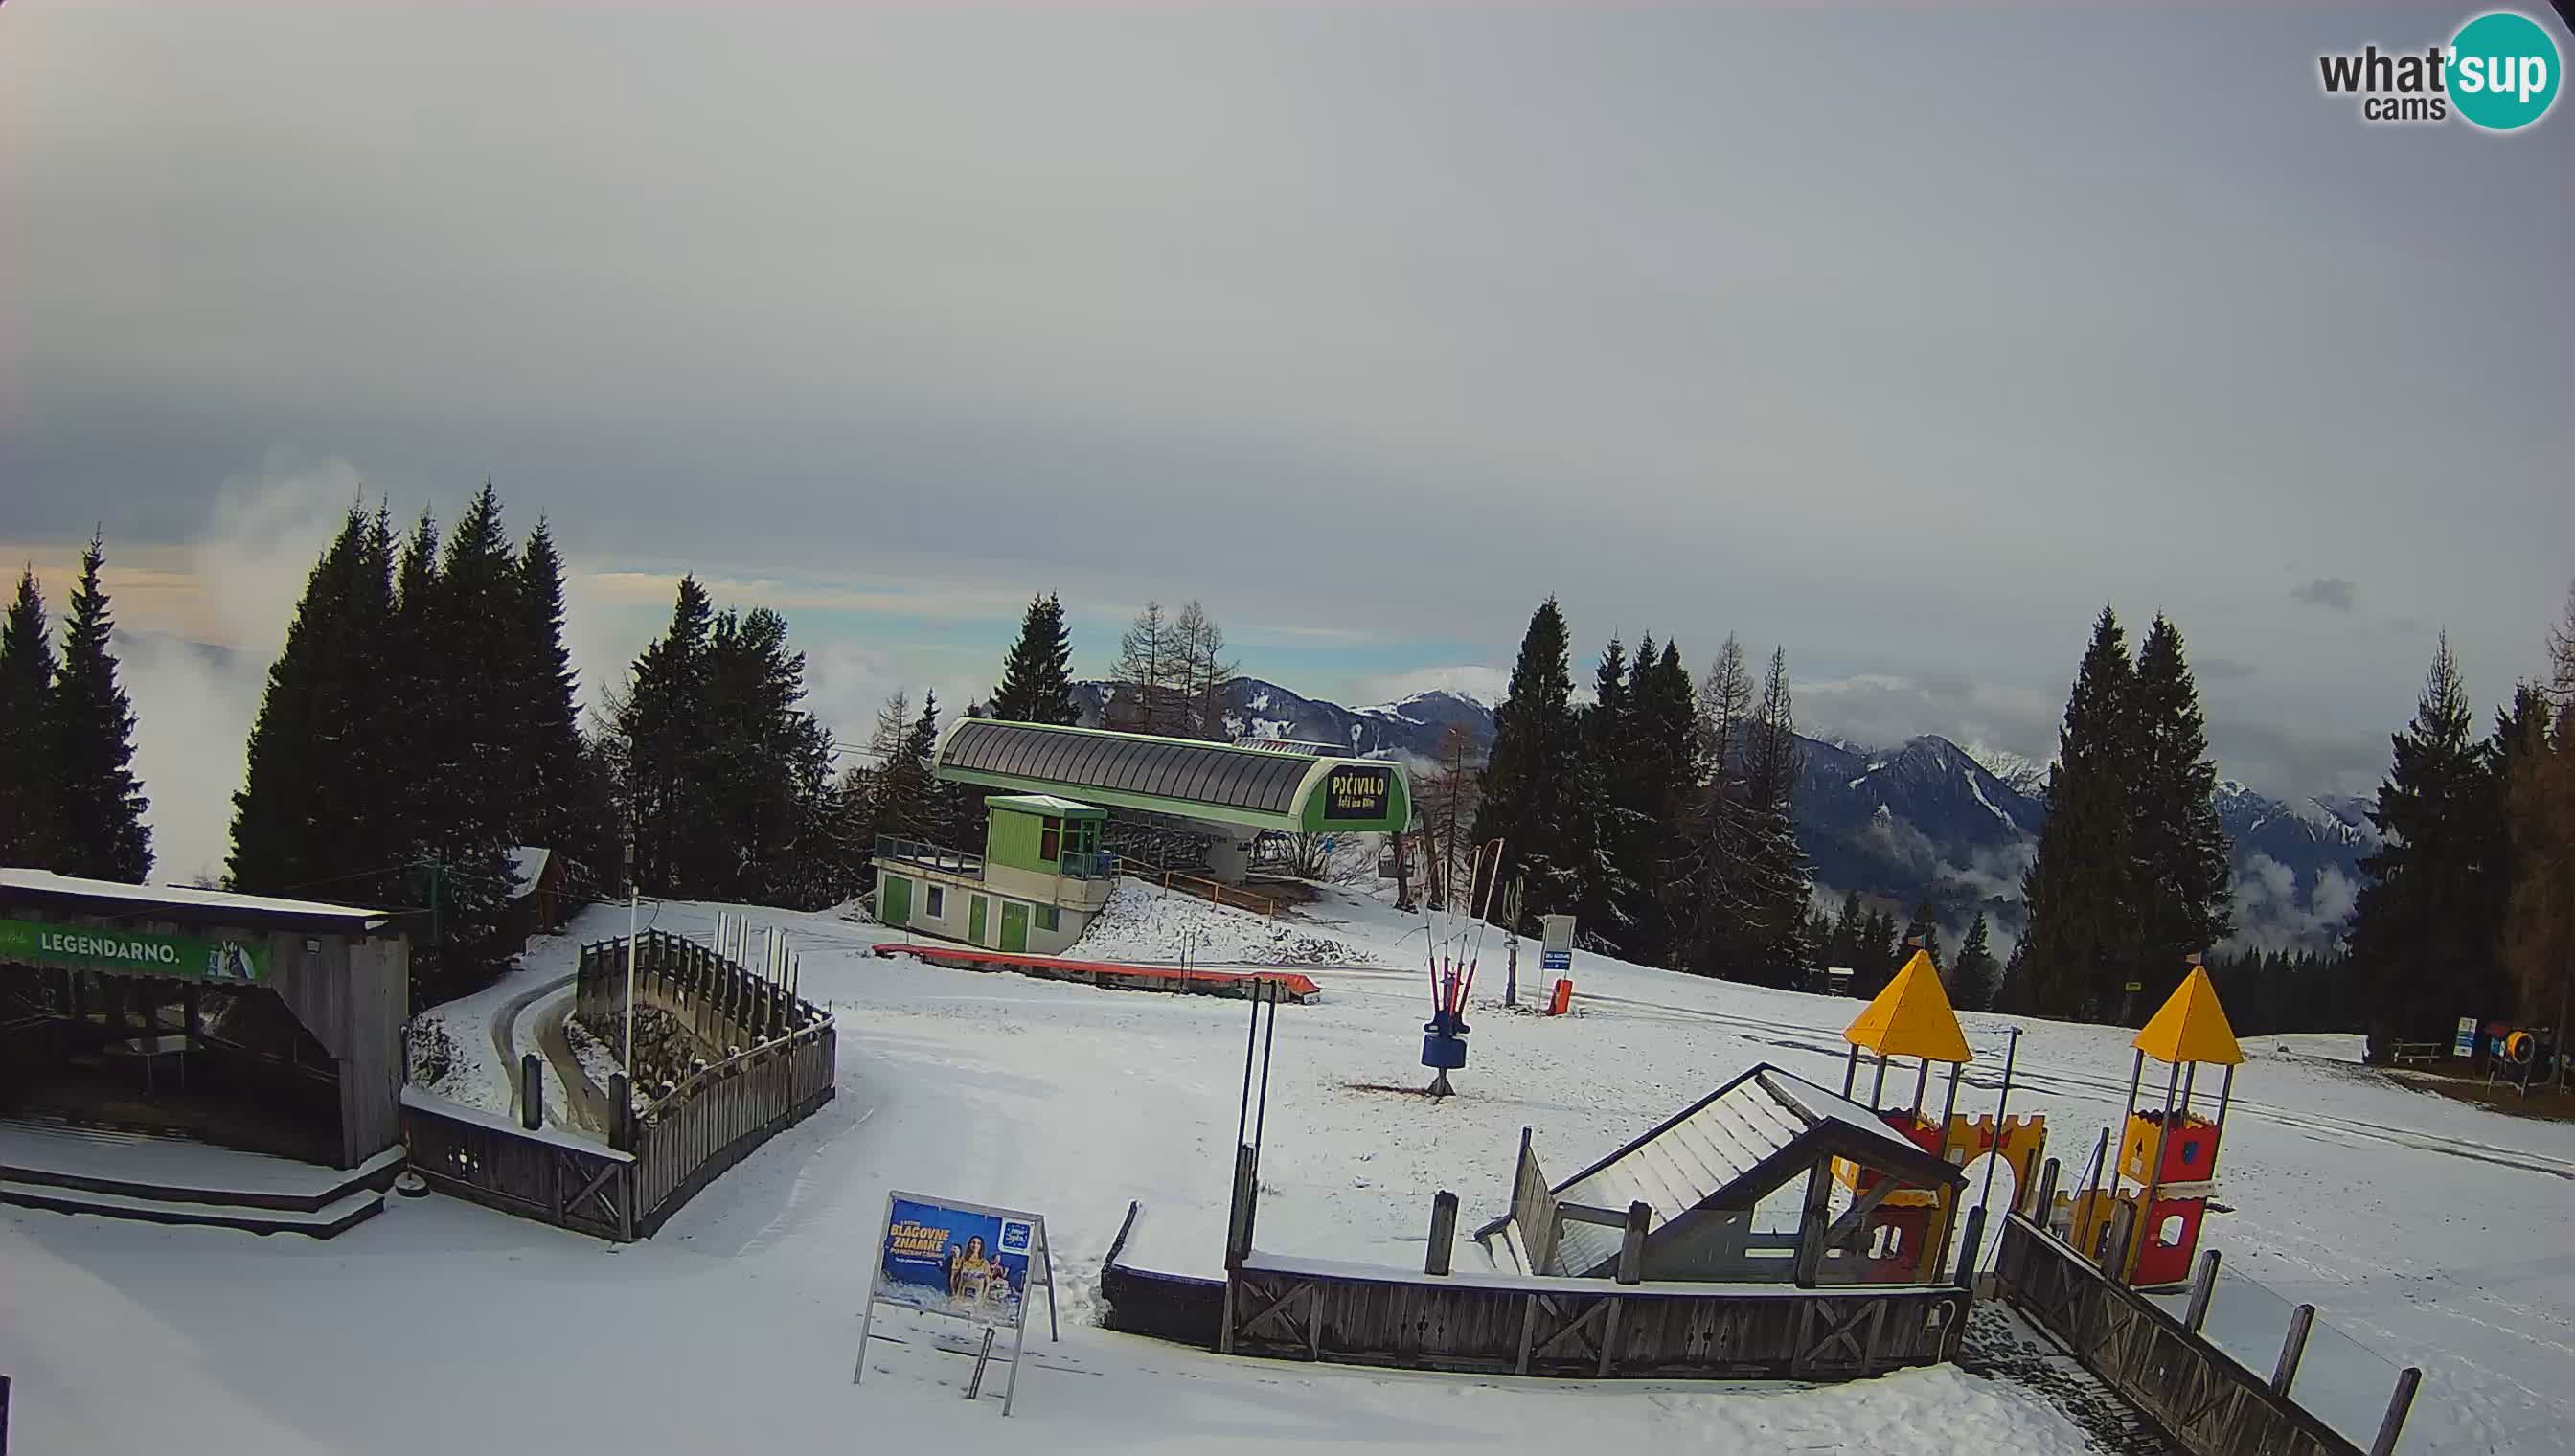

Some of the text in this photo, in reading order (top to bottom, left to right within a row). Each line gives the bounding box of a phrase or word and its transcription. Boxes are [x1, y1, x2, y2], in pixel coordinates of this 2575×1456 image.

[41, 932, 181, 965] LEGENDARNO.
[890, 1224, 950, 1241] BLAGOVNE
[893, 1236, 944, 1252] ZNAMKE
